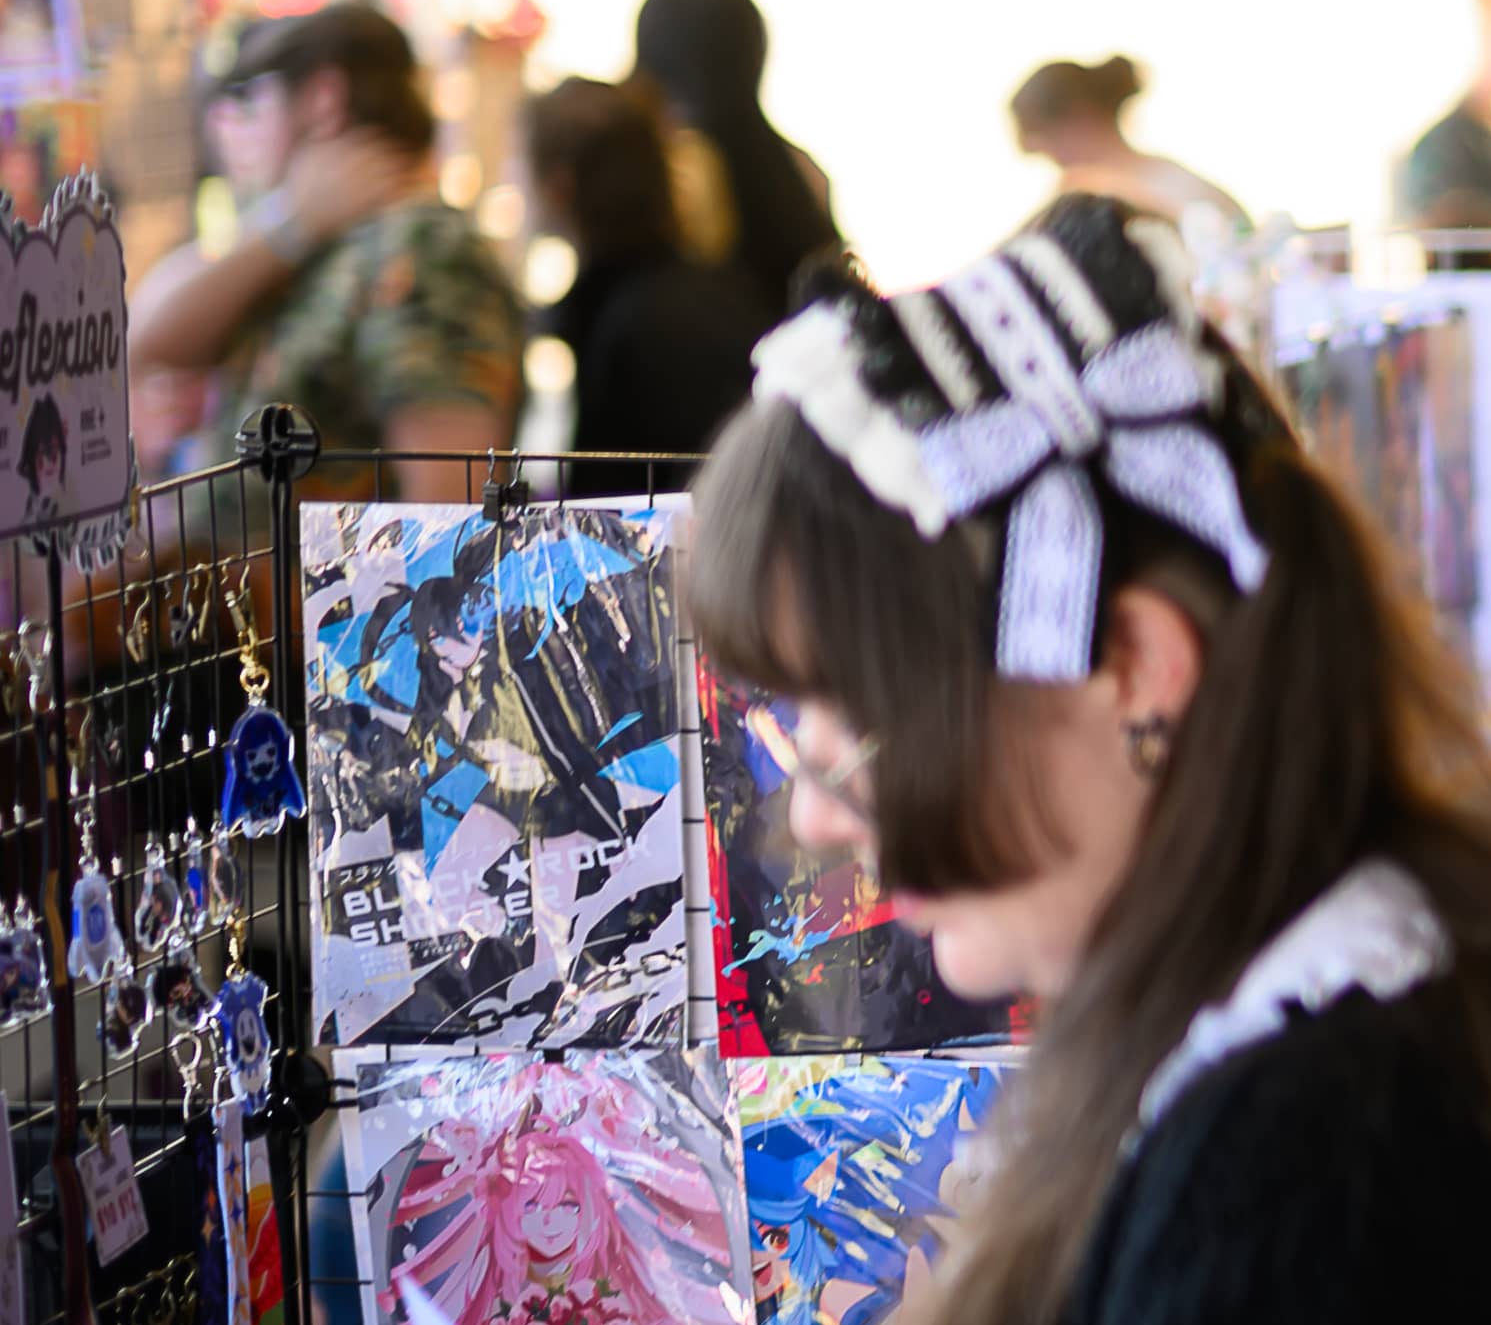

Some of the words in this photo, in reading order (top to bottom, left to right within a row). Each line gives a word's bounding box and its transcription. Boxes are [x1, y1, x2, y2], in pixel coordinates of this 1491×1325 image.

[0, 288, 120, 405] eflexion
[343, 866, 490, 918] BLCK
[537, 833, 652, 878] ROCK
